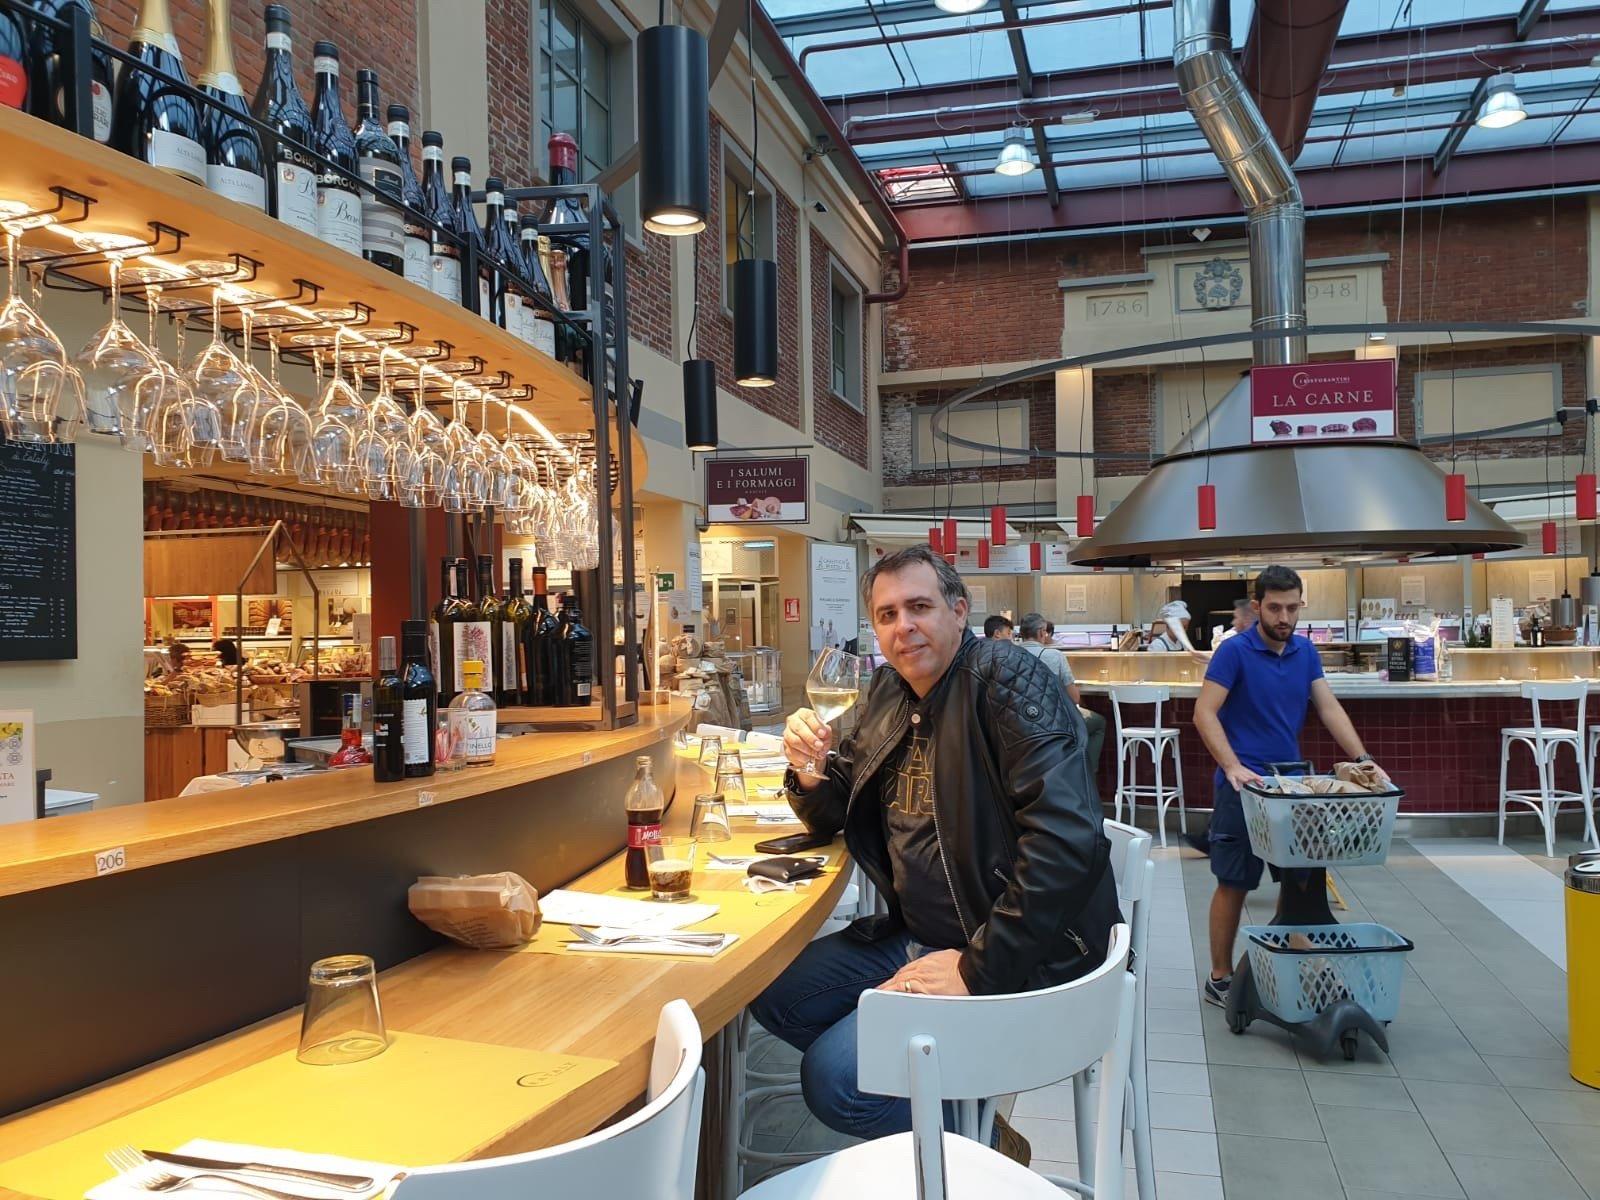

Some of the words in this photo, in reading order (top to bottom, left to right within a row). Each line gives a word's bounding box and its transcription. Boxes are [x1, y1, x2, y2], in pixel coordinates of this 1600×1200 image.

[1306, 283, 1351, 300] 948
[1091, 300, 1143, 317] 1786
[1272, 394, 1297, 407] LA
[1304, 389, 1374, 406] CARNE
[730, 468, 734, 478] I
[738, 467, 782, 477] SALUMI
[716, 480, 723, 489] E
[727, 480, 731, 488] I
[735, 478, 796, 488] FORMAGGI
[97, 851, 124, 872] 206
